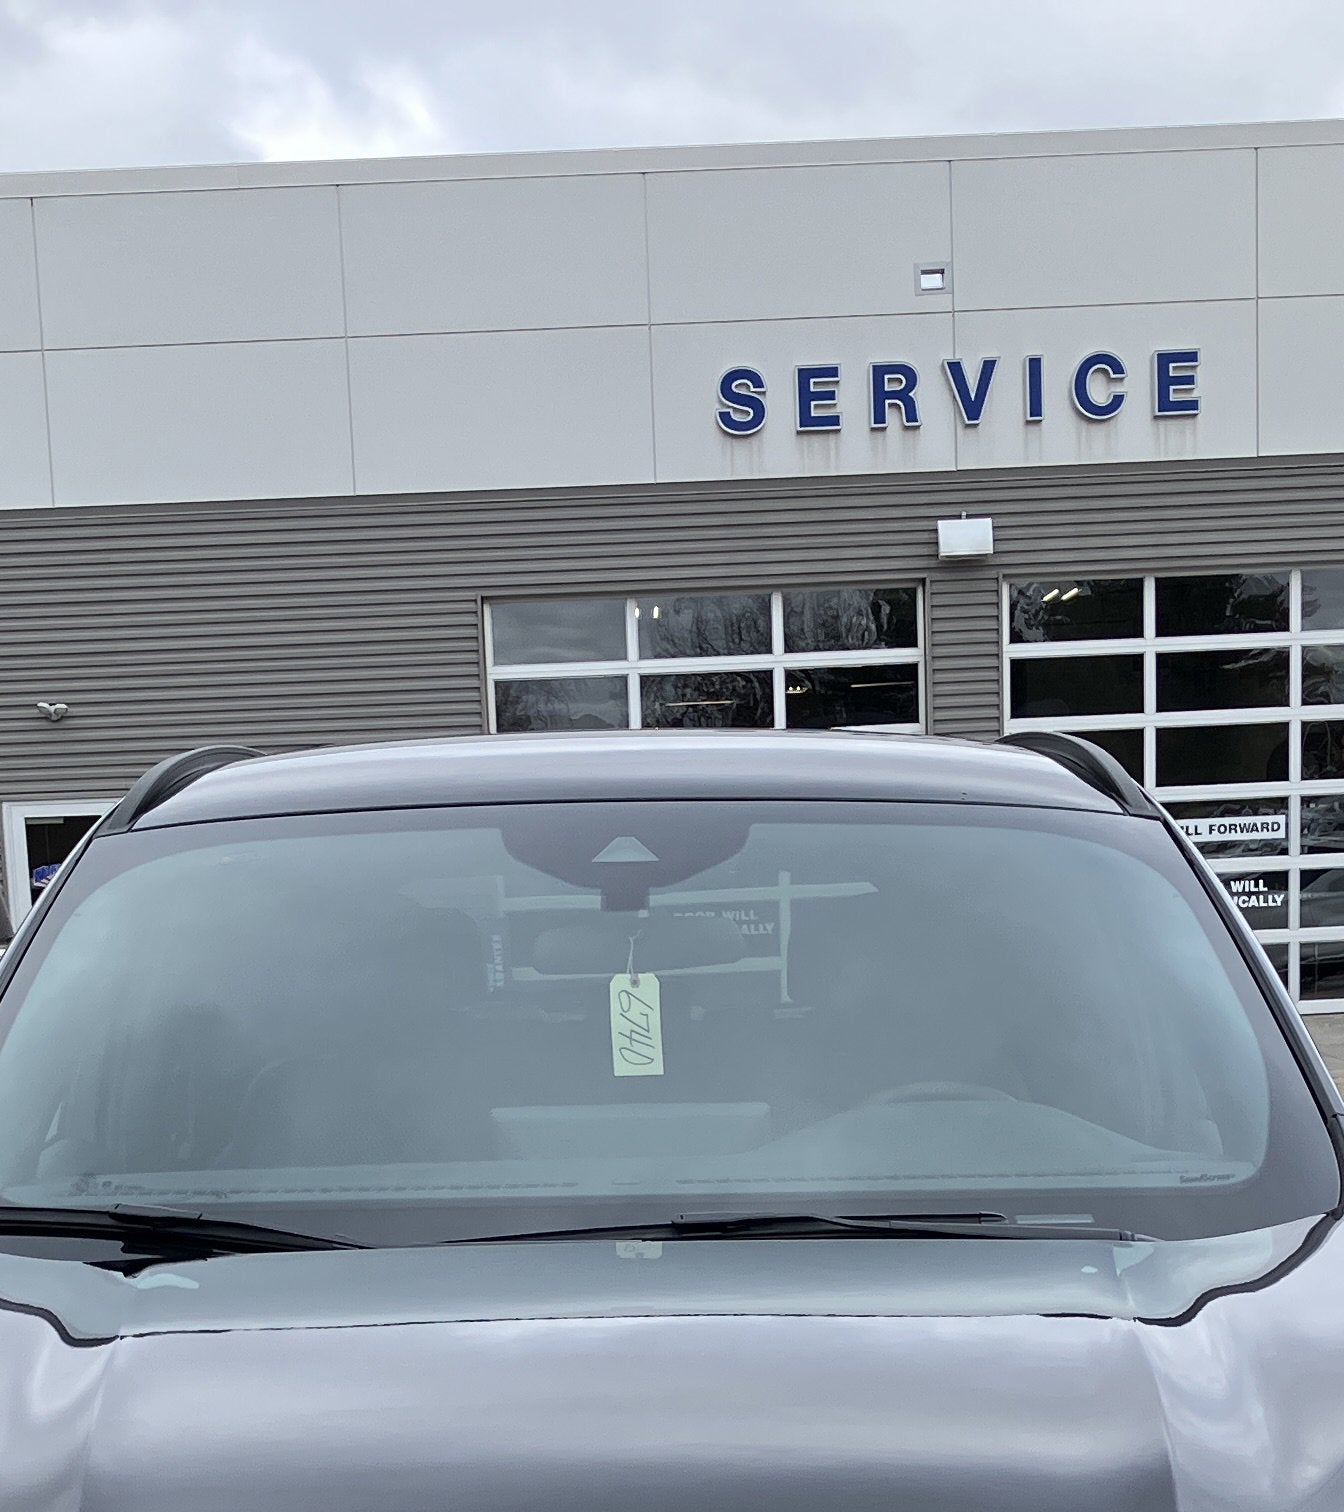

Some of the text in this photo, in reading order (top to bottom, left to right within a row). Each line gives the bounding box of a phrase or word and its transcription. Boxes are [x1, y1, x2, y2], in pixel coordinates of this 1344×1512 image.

[716, 348, 1201, 435] SERVICE
[1209, 822, 1281, 835] FORWARD
[1230, 880, 1267, 892] WILL
[722, 910, 758, 921] WILL
[618, 990, 655, 1066] 6740
